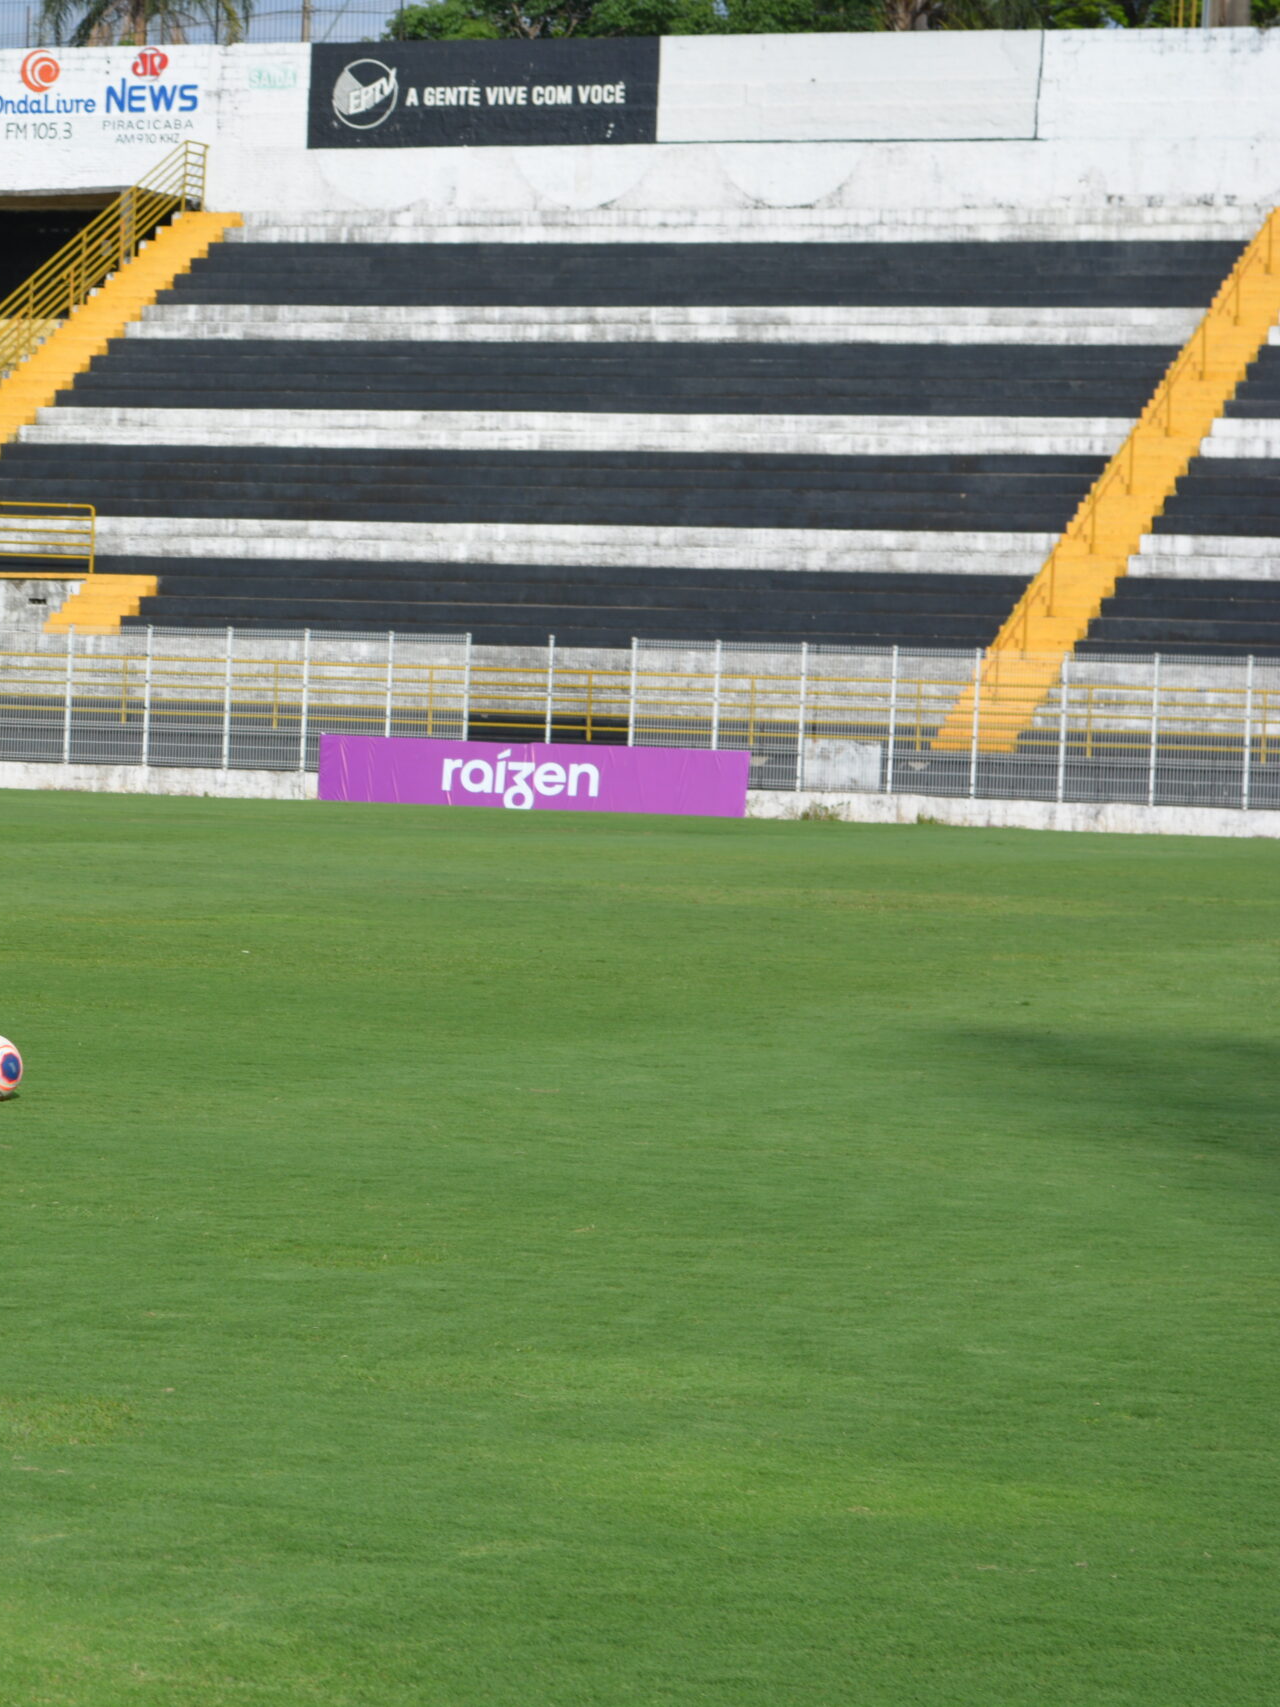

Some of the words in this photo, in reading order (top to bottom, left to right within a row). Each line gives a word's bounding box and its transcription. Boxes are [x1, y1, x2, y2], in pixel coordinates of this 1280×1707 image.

[106, 77, 198, 113] NEWS
[349, 67, 397, 115] EPTV
[405, 87, 419, 106] A
[423, 86, 480, 106] GENTE
[485, 86, 527, 105] VIVE
[532, 85, 573, 105] COM
[577, 81, 625, 104] VOCÊ
[5, 122, 27, 140] FM
[32, 122, 73, 140] 105.3
[102, 119, 194, 130] PIRACICABA
[442, 748, 600, 810] raízen
